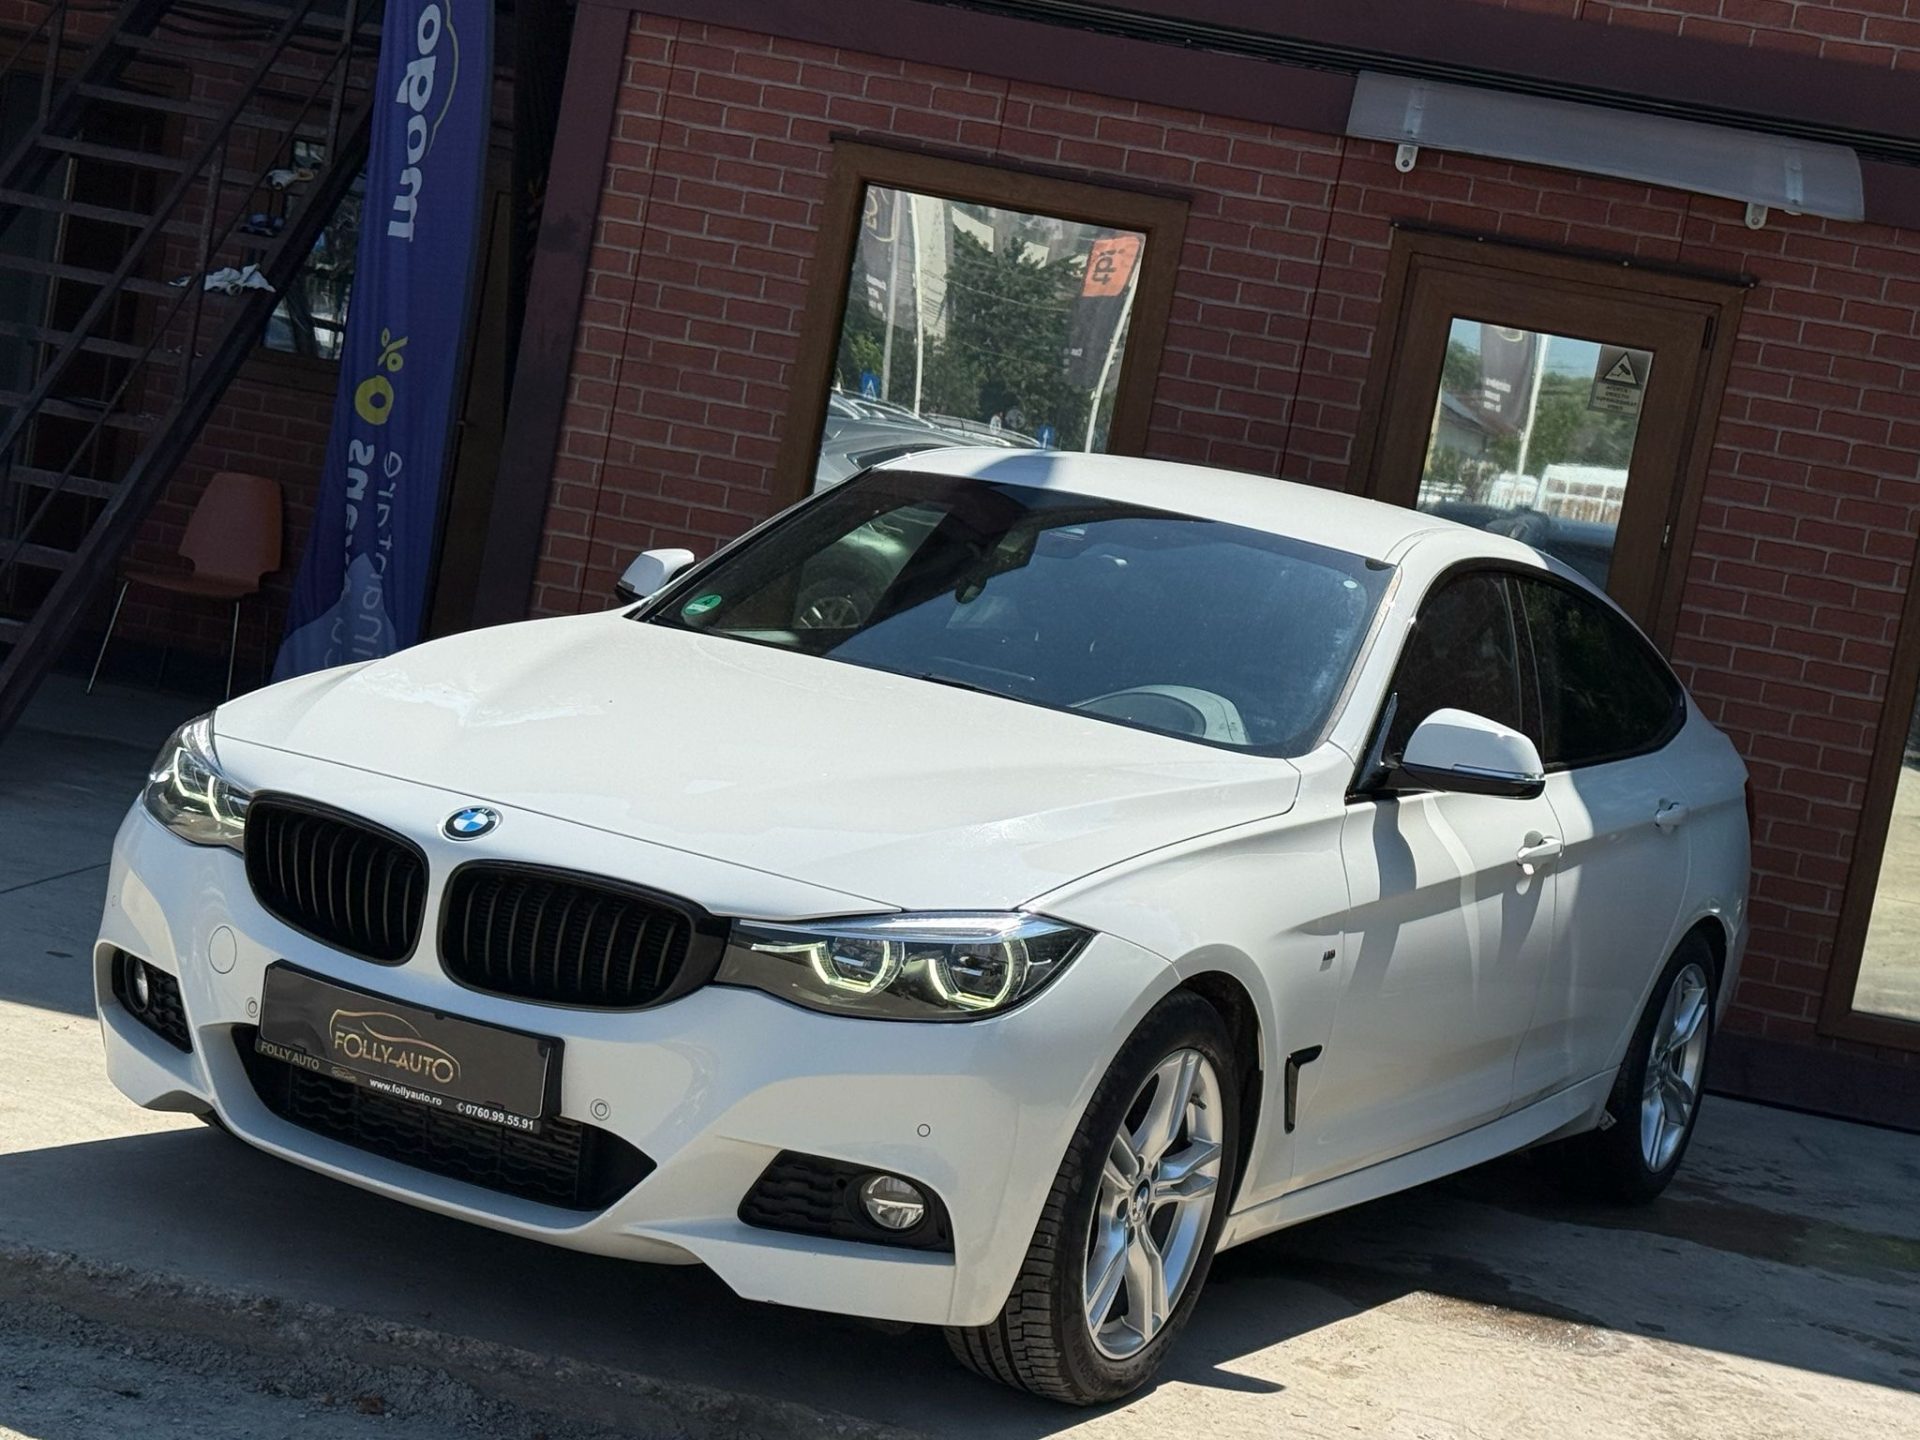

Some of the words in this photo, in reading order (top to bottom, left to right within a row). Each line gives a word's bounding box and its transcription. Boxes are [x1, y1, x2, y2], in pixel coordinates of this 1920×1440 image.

[260, 1041, 292, 1060] FOLLY
[292, 1053, 320, 1070] AUTO
[334, 1031, 394, 1064] FOLLY
[394, 1050, 454, 1084] AUTO
[369, 1078, 442, 1106] www.follyauto.ro
[465, 1107, 534, 1131] 0760.99.55.91
